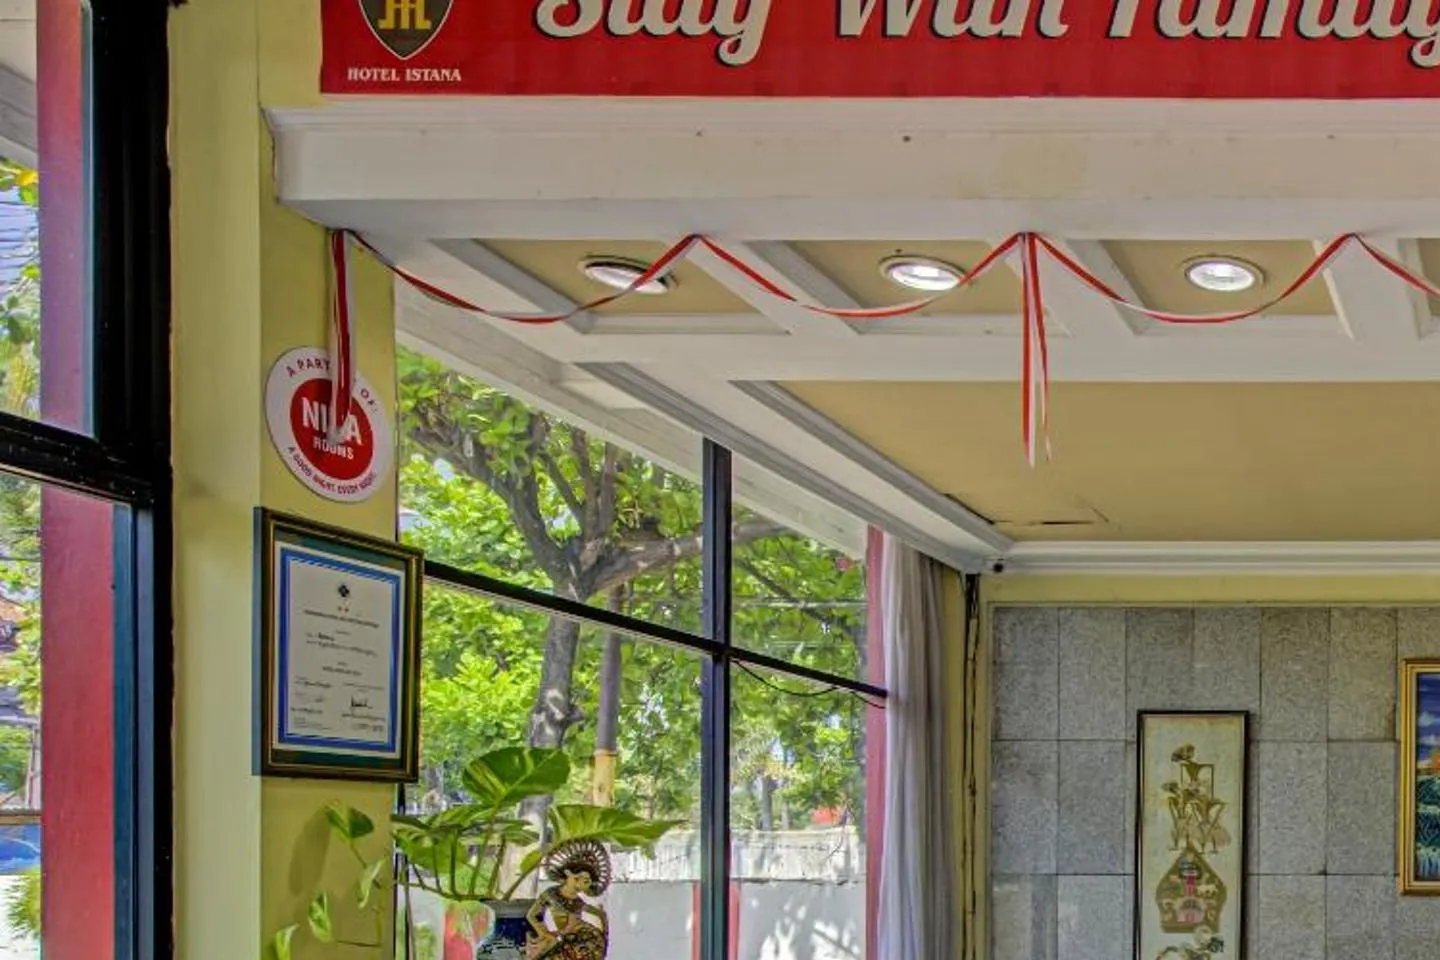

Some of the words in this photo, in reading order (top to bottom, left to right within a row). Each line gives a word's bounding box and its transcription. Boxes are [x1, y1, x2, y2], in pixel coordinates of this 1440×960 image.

[347, 67, 401, 82] HOTEL
[405, 67, 462, 82] ISTANA
[302, 396, 363, 447] NIA
